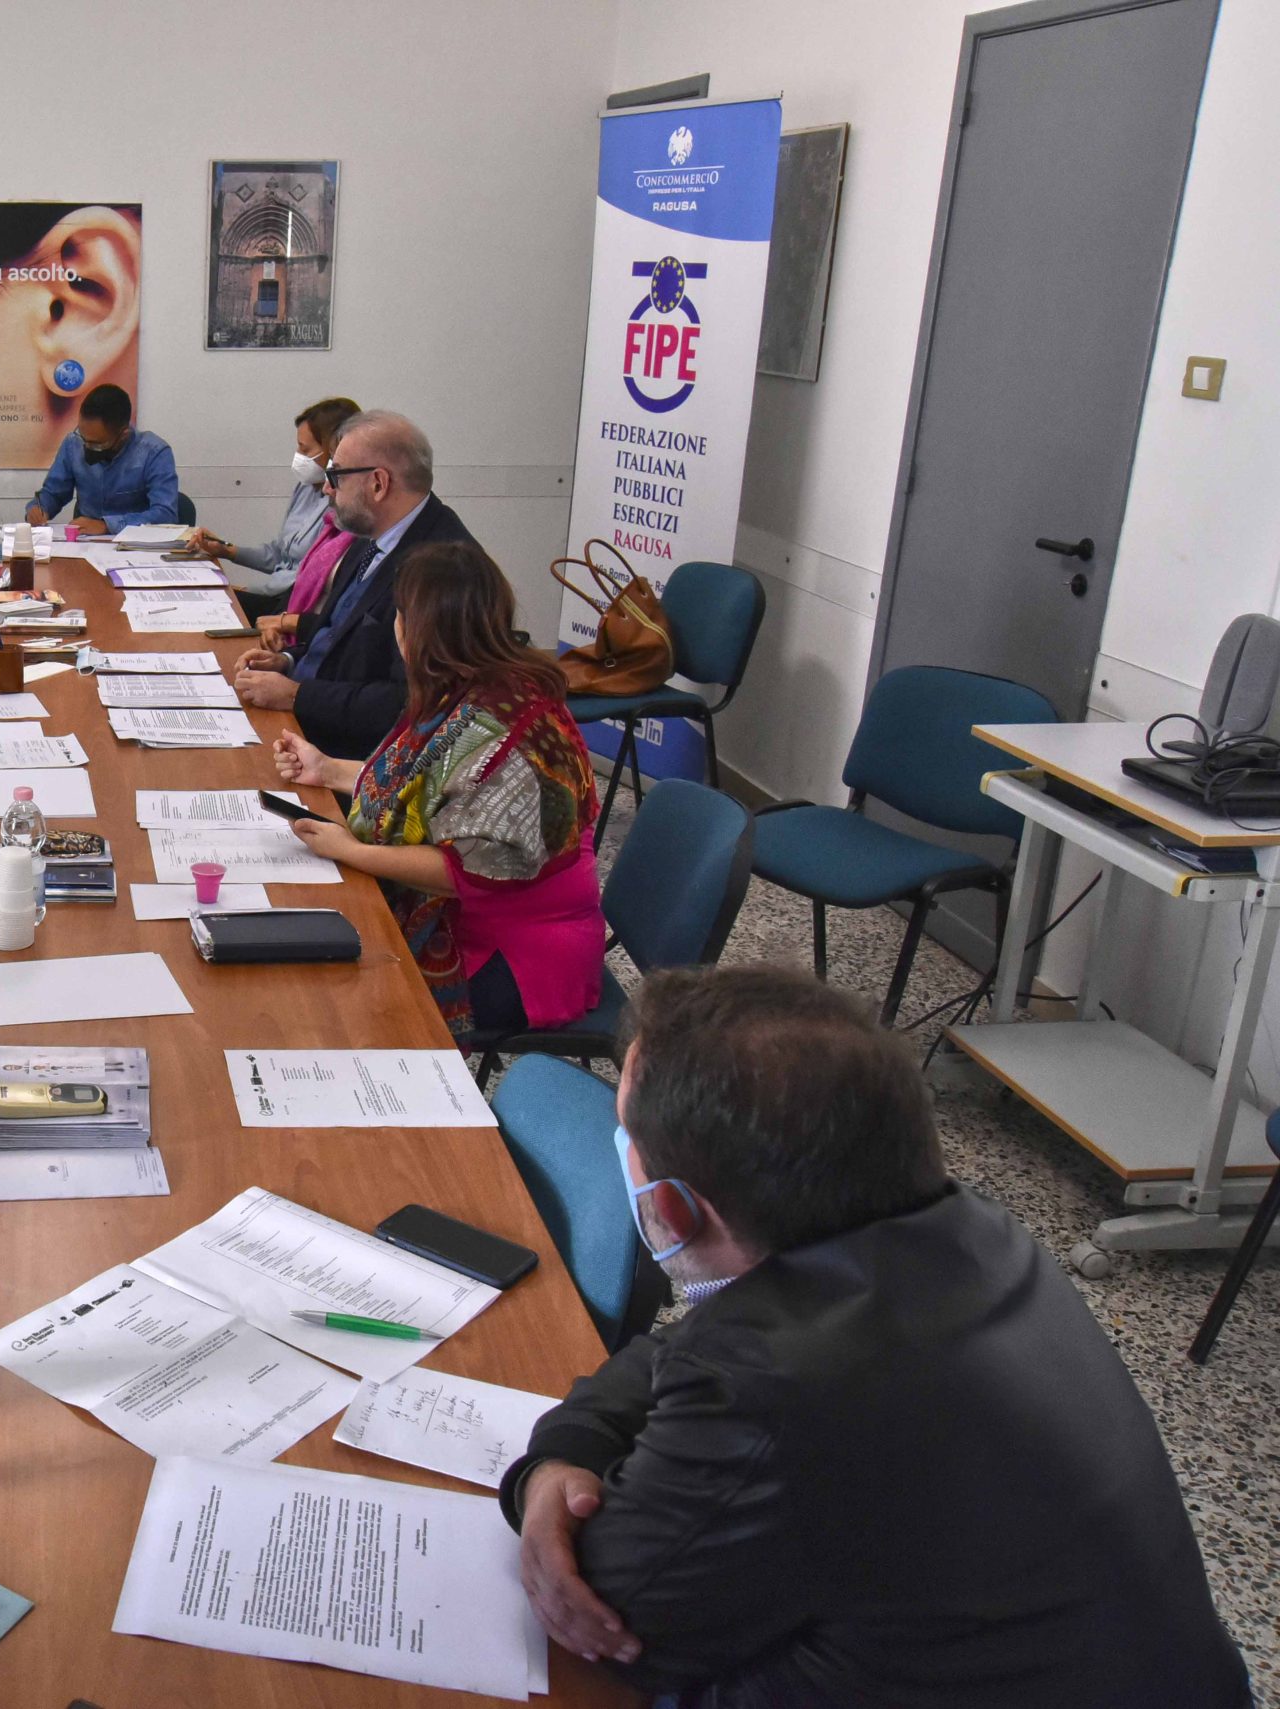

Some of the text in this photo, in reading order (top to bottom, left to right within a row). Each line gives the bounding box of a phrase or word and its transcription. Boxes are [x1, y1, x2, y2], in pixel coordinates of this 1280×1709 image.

[636, 170, 719, 188] CONFCOMMERCIO
[652, 200, 698, 212] RAGUSA
[8, 263, 82, 281] ascolto.
[290, 323, 323, 340] RAGUSA
[623, 322, 701, 382] FIPE
[600, 421, 708, 456] FEDERAZIONE
[616, 450, 686, 481] ITALIANA
[613, 476, 684, 508] PUBBLICI
[612, 502, 679, 534] ESERCIZI
[613, 528, 673, 560] RAGUSA
[609, 568, 631, 583] Roma
[572, 621, 597, 638] www
